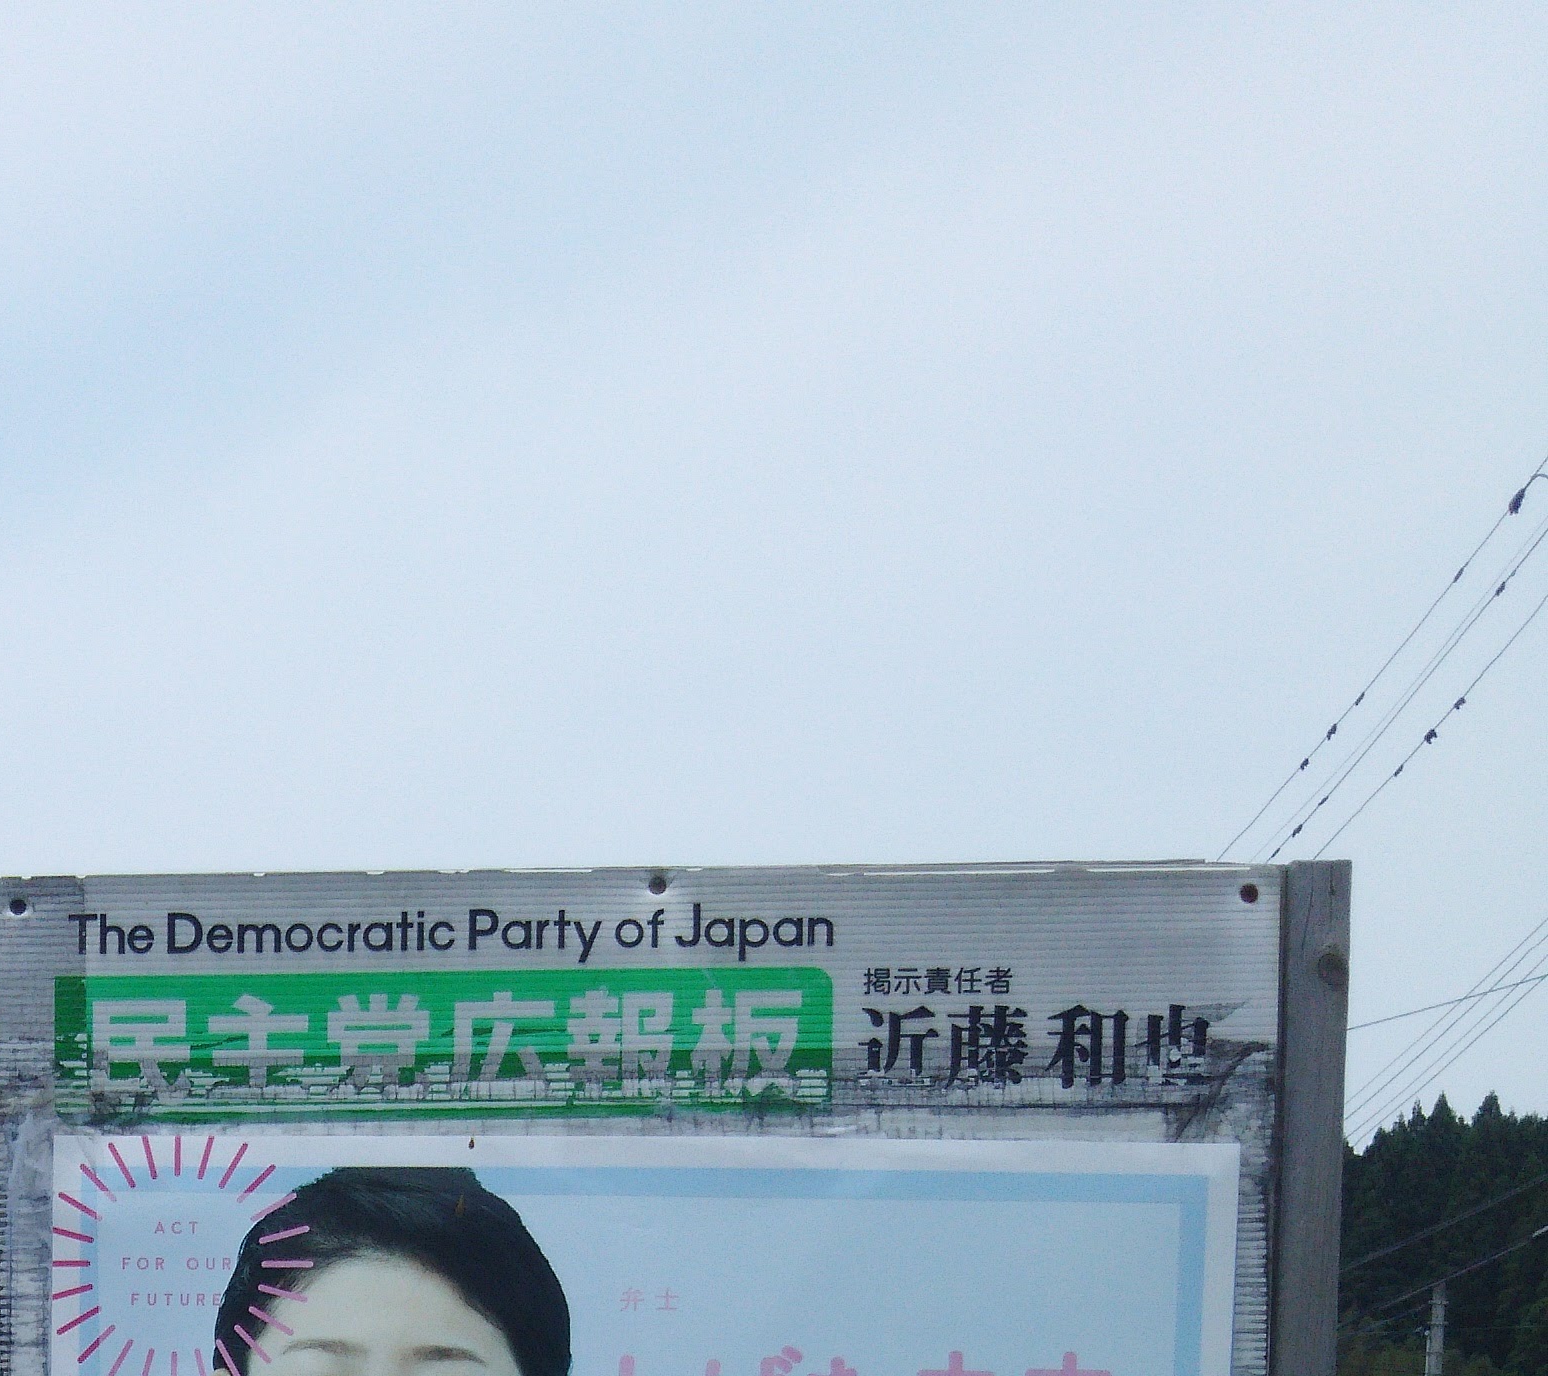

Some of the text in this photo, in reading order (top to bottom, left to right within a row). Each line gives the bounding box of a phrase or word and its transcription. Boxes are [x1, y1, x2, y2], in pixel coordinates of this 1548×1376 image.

[69, 904, 834, 962] The Democratic Party of Japan
[864, 967, 1012, 995] 掲示責任者
[91, 990, 802, 1098] 民主党広報板
[154, 1221, 198, 1235] ACT
[122, 1257, 232, 1270] FOR OUR
[131, 1293, 222, 1306] FUTURE
[619, 1286, 679, 1313] 弁士
